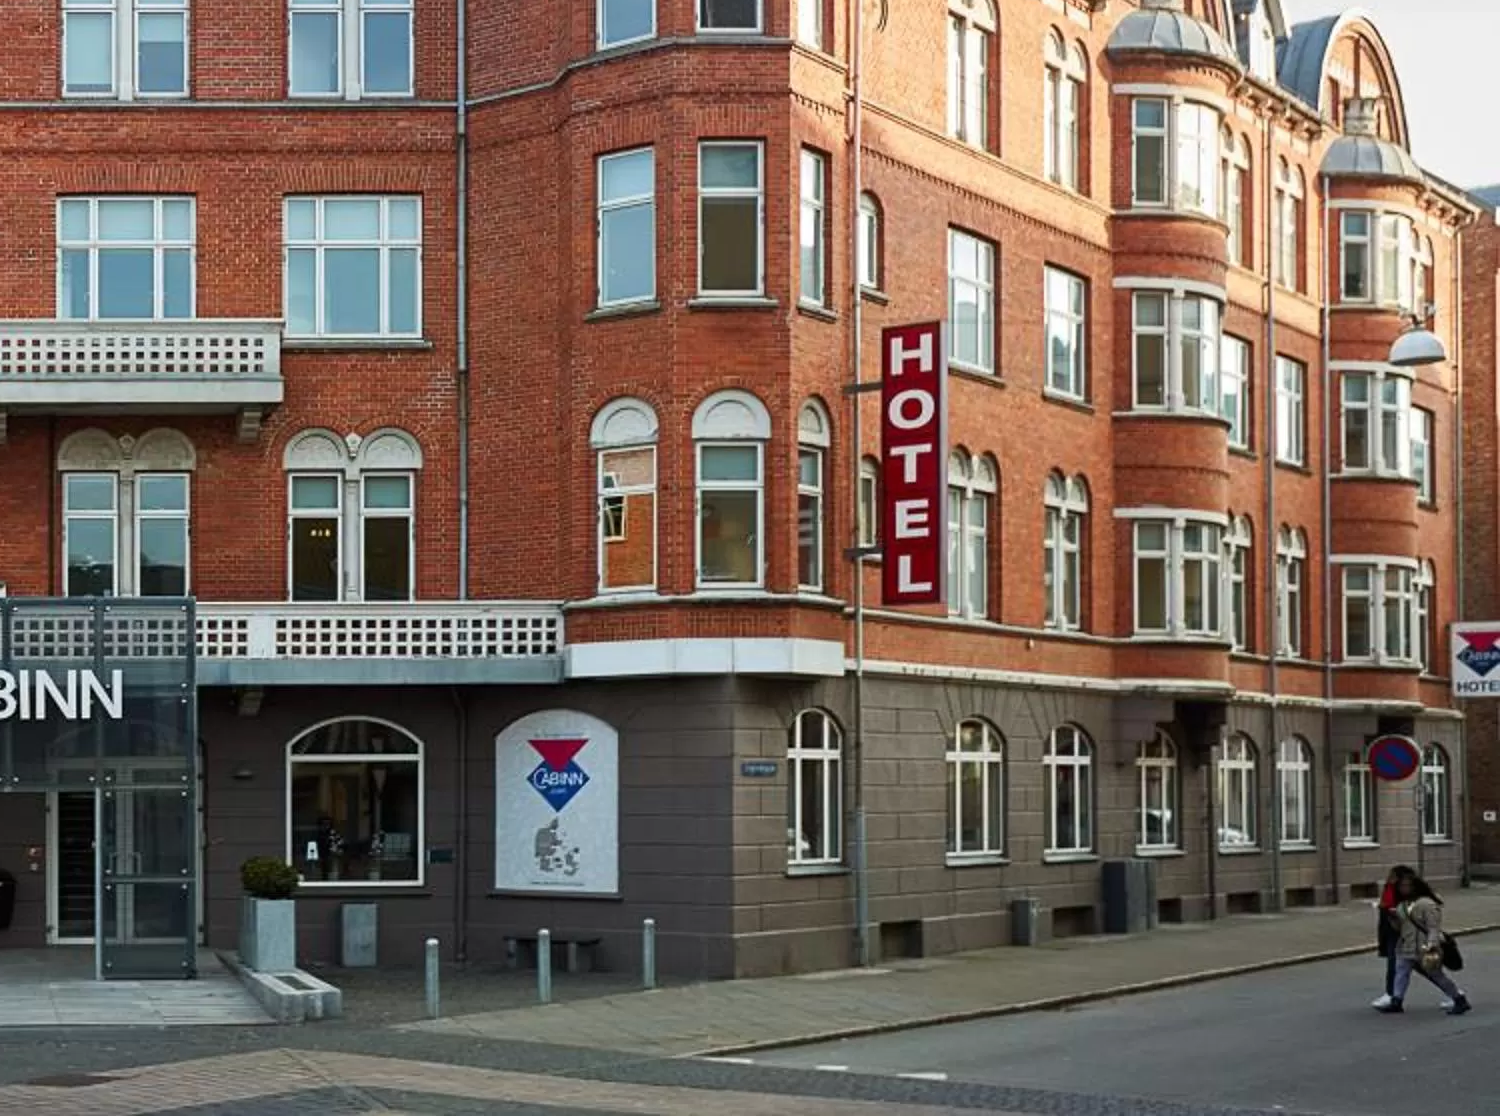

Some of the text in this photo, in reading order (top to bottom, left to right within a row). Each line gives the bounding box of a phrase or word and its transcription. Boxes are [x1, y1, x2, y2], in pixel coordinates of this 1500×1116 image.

[888, 332, 935, 593] HOTEL
[1457, 680, 1500, 692] HOTE
[533, 768, 583, 789] CABINN
